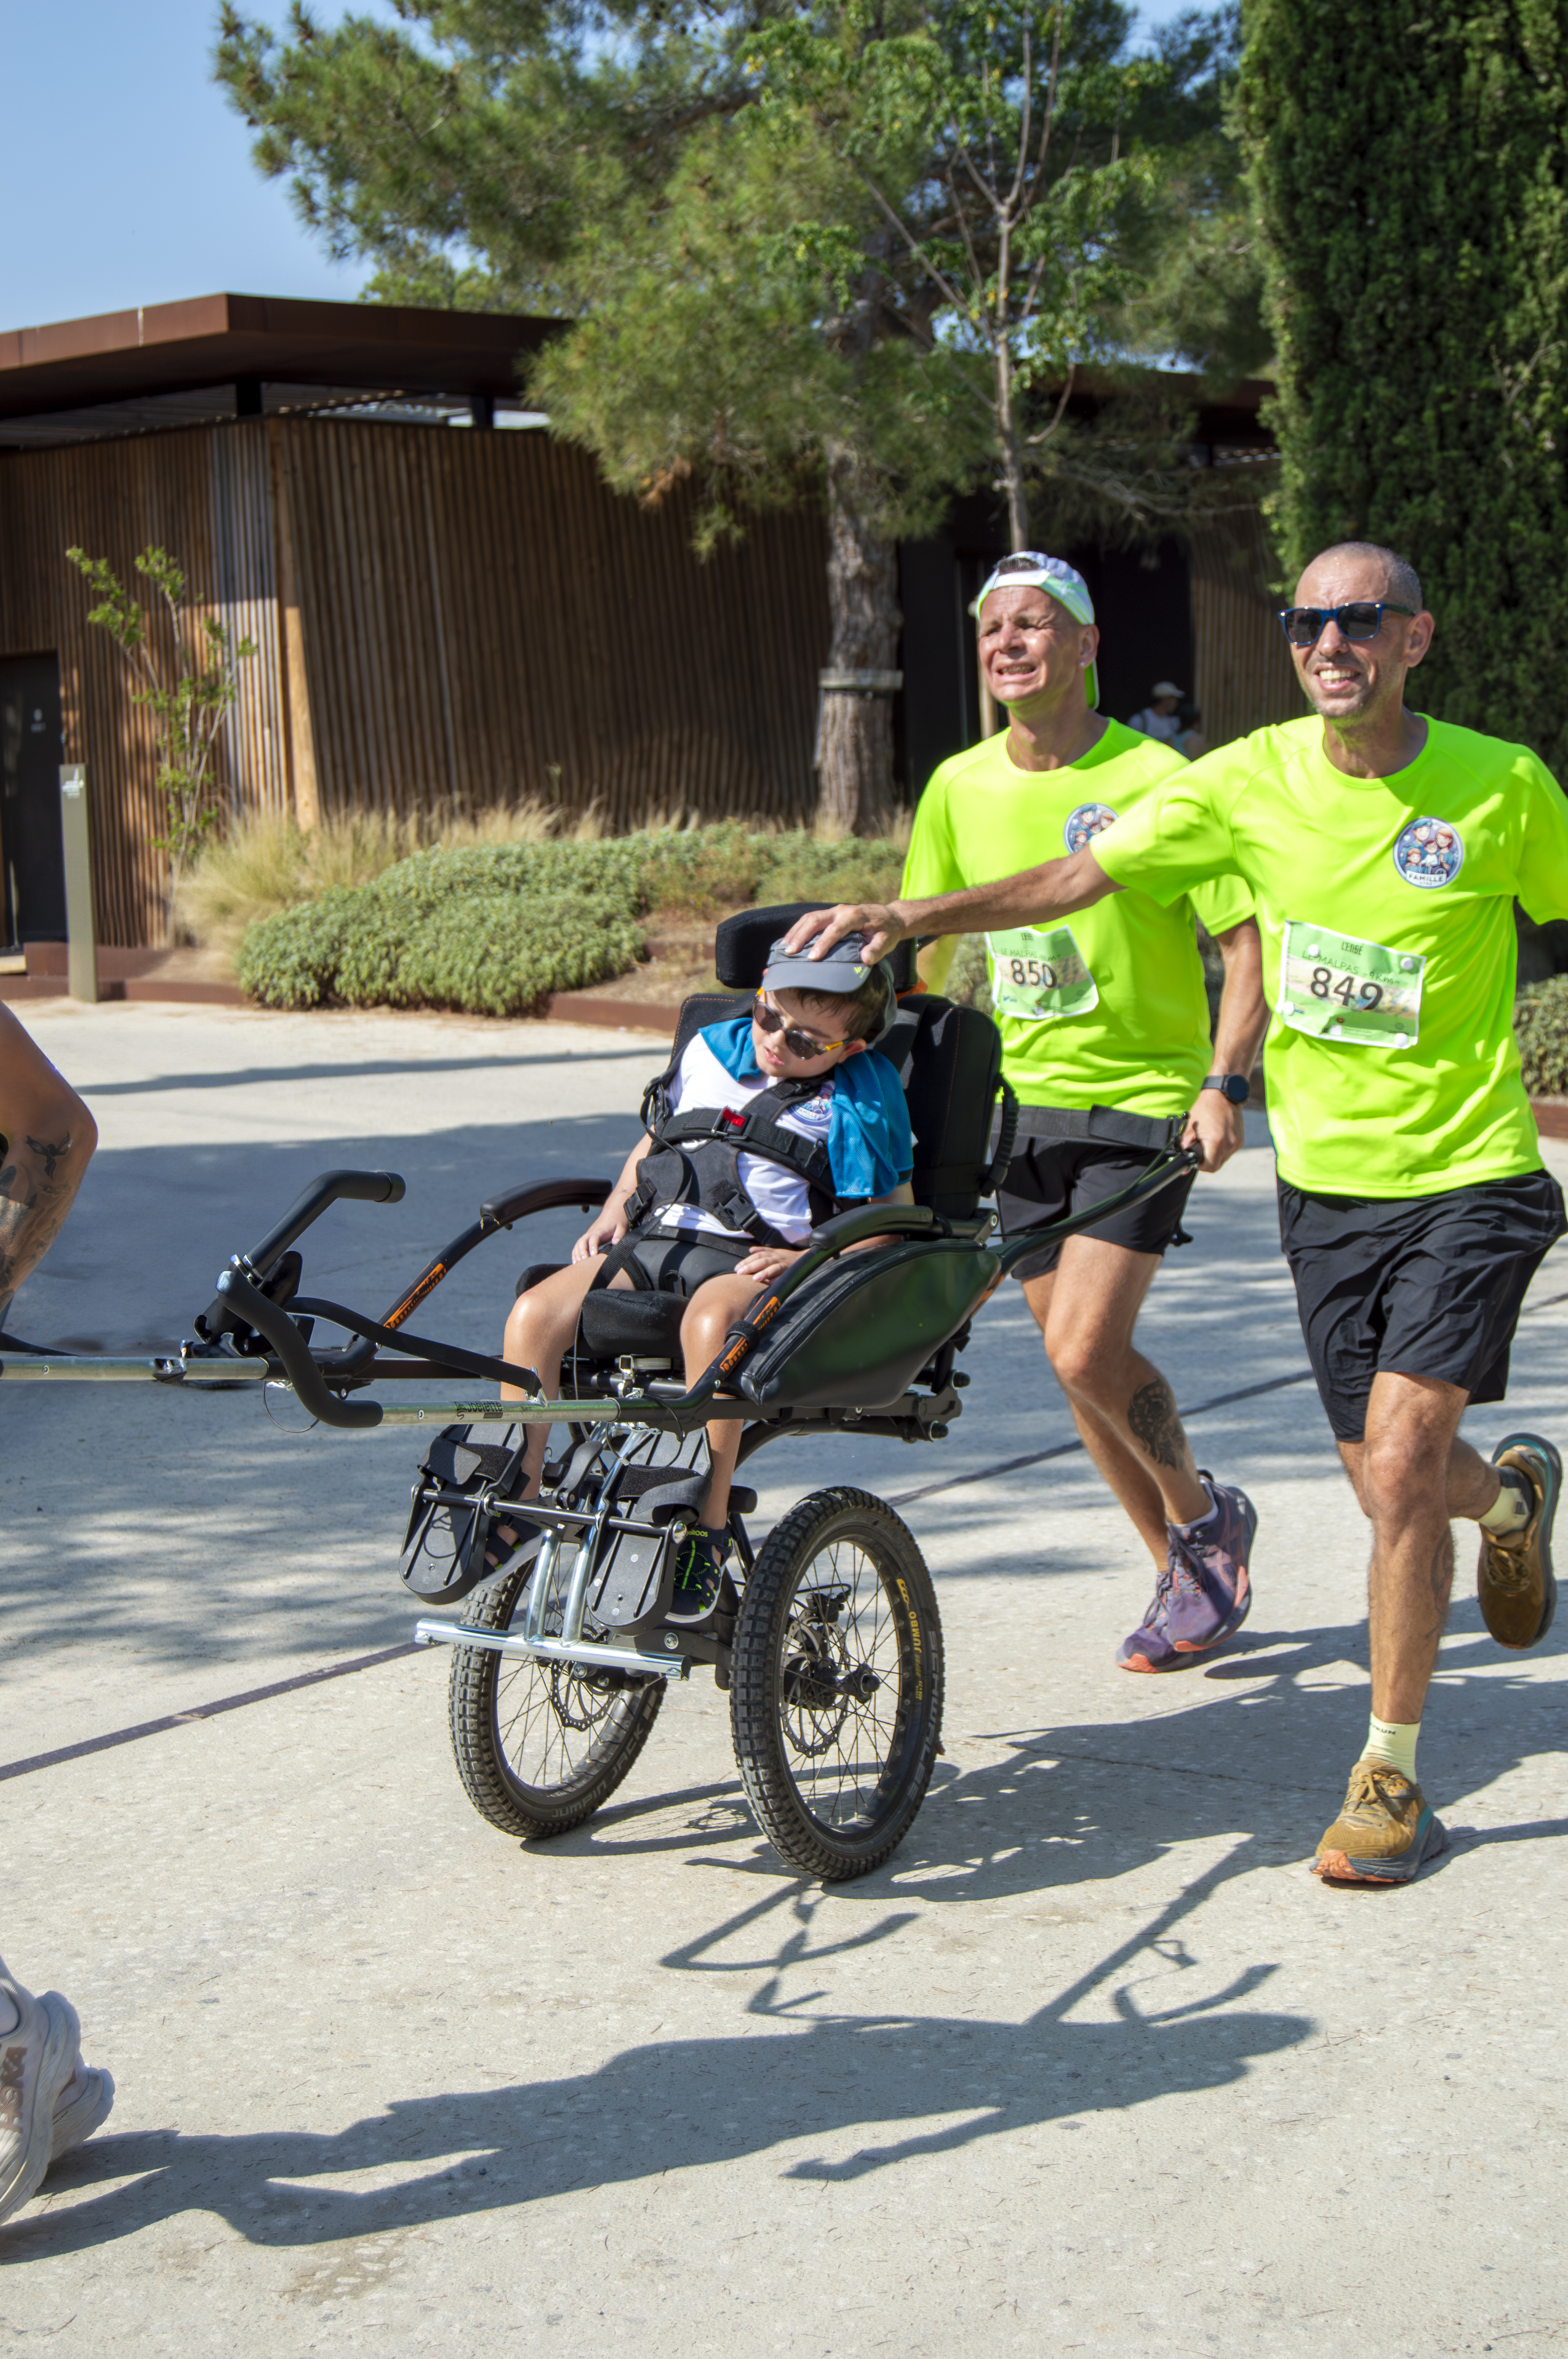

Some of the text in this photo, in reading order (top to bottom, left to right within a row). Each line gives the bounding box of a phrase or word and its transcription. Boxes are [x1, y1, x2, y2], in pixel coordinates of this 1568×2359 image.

[1409, 873, 1444, 882] FAMILLE
[1010, 949, 1037, 958] MALPAS
[1318, 956, 1359, 974] MALPAS
[1011, 958, 1058, 988] 850
[1310, 967, 1383, 1010] 849
[796, 1106, 818, 1118] FAMILLE
[909, 1611, 922, 1653] JUMBO
[907, 1630, 939, 1801] SCHWALBE
[552, 1723, 645, 1818] JUMPIN JACK
